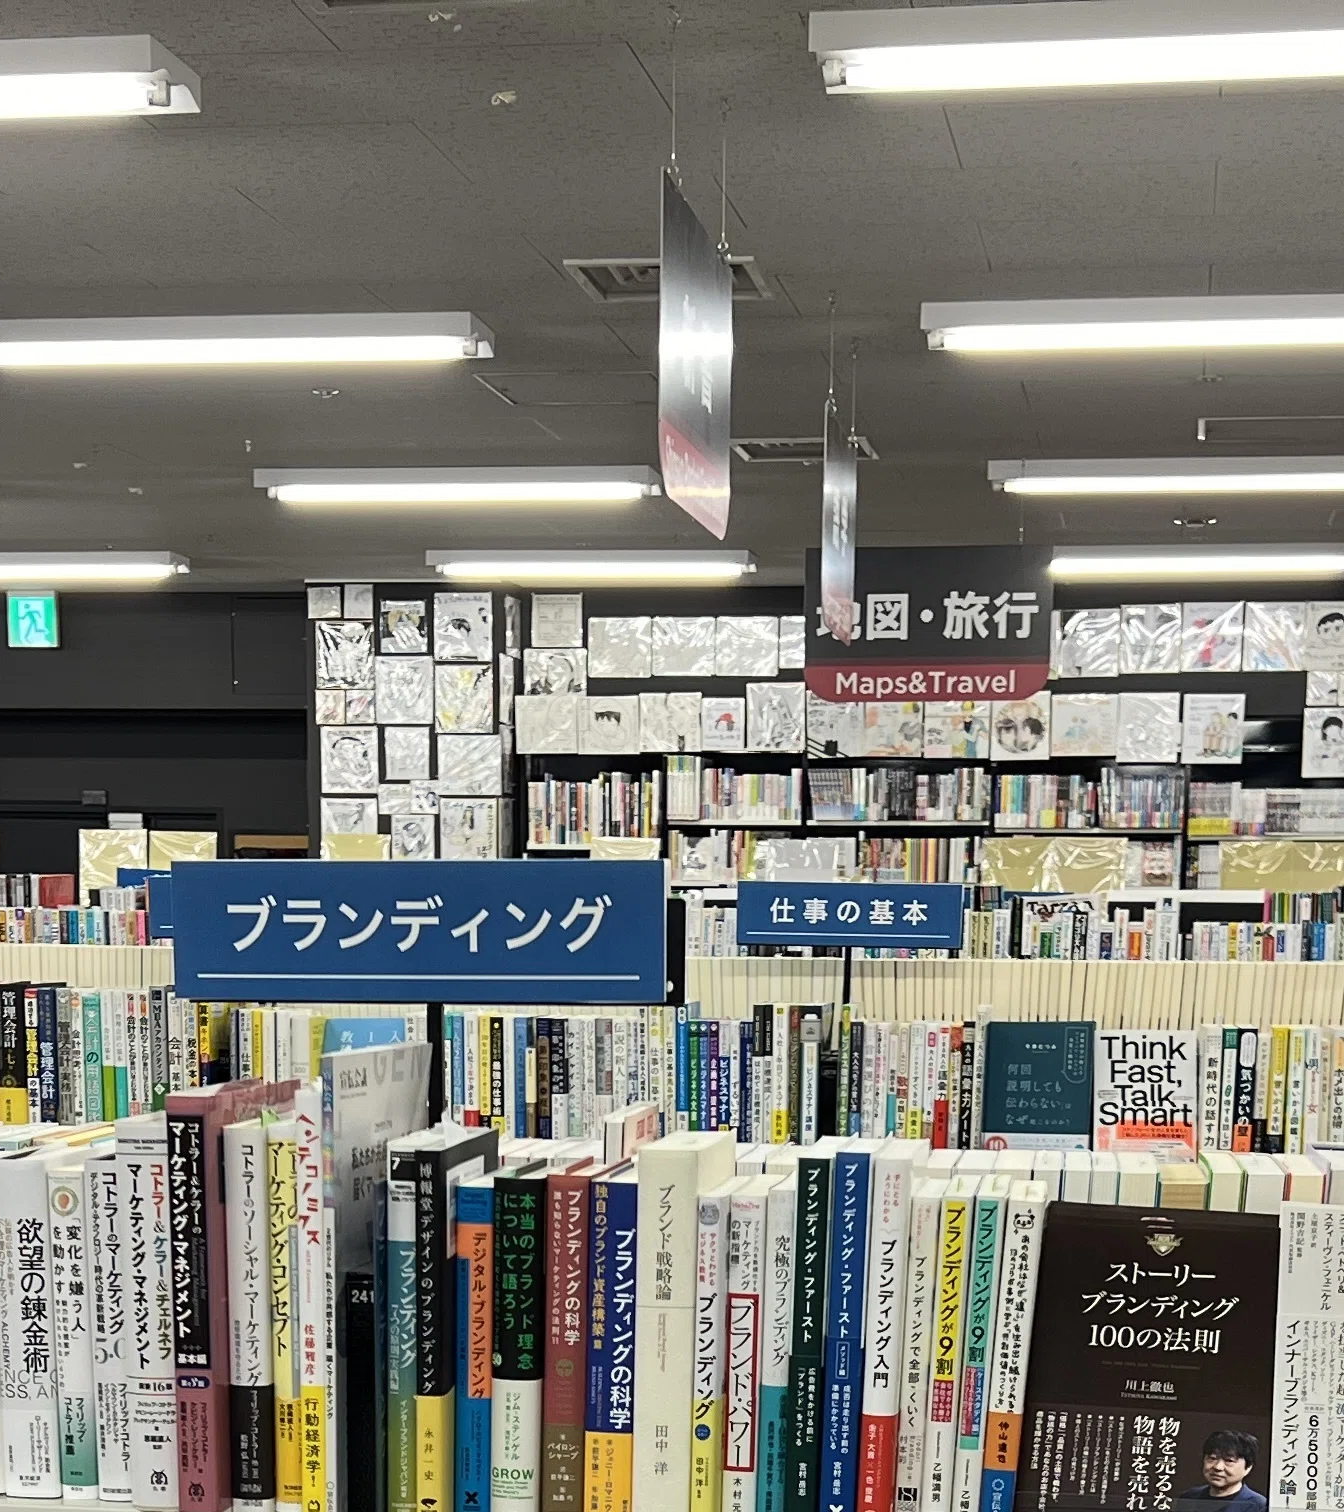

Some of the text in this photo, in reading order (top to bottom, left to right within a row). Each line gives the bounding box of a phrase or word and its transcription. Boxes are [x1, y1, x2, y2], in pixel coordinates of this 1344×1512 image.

[836, 670, 1016, 698] Maps&Travel
[225, 893, 613, 954] ブランディング
[770, 896, 929, 926] 仕事の基本
[1101, 1036, 1186, 1060] Think
[1111, 1061, 1182, 1088] Fast,
[1115, 1086, 1174, 1106] Talk
[1099, 1101, 1193, 1127] Smart
[126, 1162, 151, 1370] マーケティング・マネジメント
[168, 1121, 192, 1340] マーケティング・マネジメント
[501, 1194, 520, 1330] について語ろう
[517, 1193, 535, 1371] 本当のブランド理念
[563, 1190, 583, 1346] ブランディングの科学
[656, 1184, 675, 1301] ブランド戦略論
[802, 1167, 821, 1344] ブランディング・ファースト
[935, 1207, 966, 1377] ブランディングが9割
[1109, 1262, 1216, 1284] ストーリー
[17, 1219, 51, 1374] 欲望の錬金術
[470, 1232, 487, 1399] デジタル・ブランディング
[608, 1229, 637, 1430] ブランディングの科学
[872, 1239, 897, 1389] ブランディング入門
[1081, 1292, 1239, 1321] ブランディング
[1088, 1324, 1221, 1355] 100の法則
[728, 1299, 755, 1468] ブランド・パワー
[492, 1468, 534, 1481] GROW
